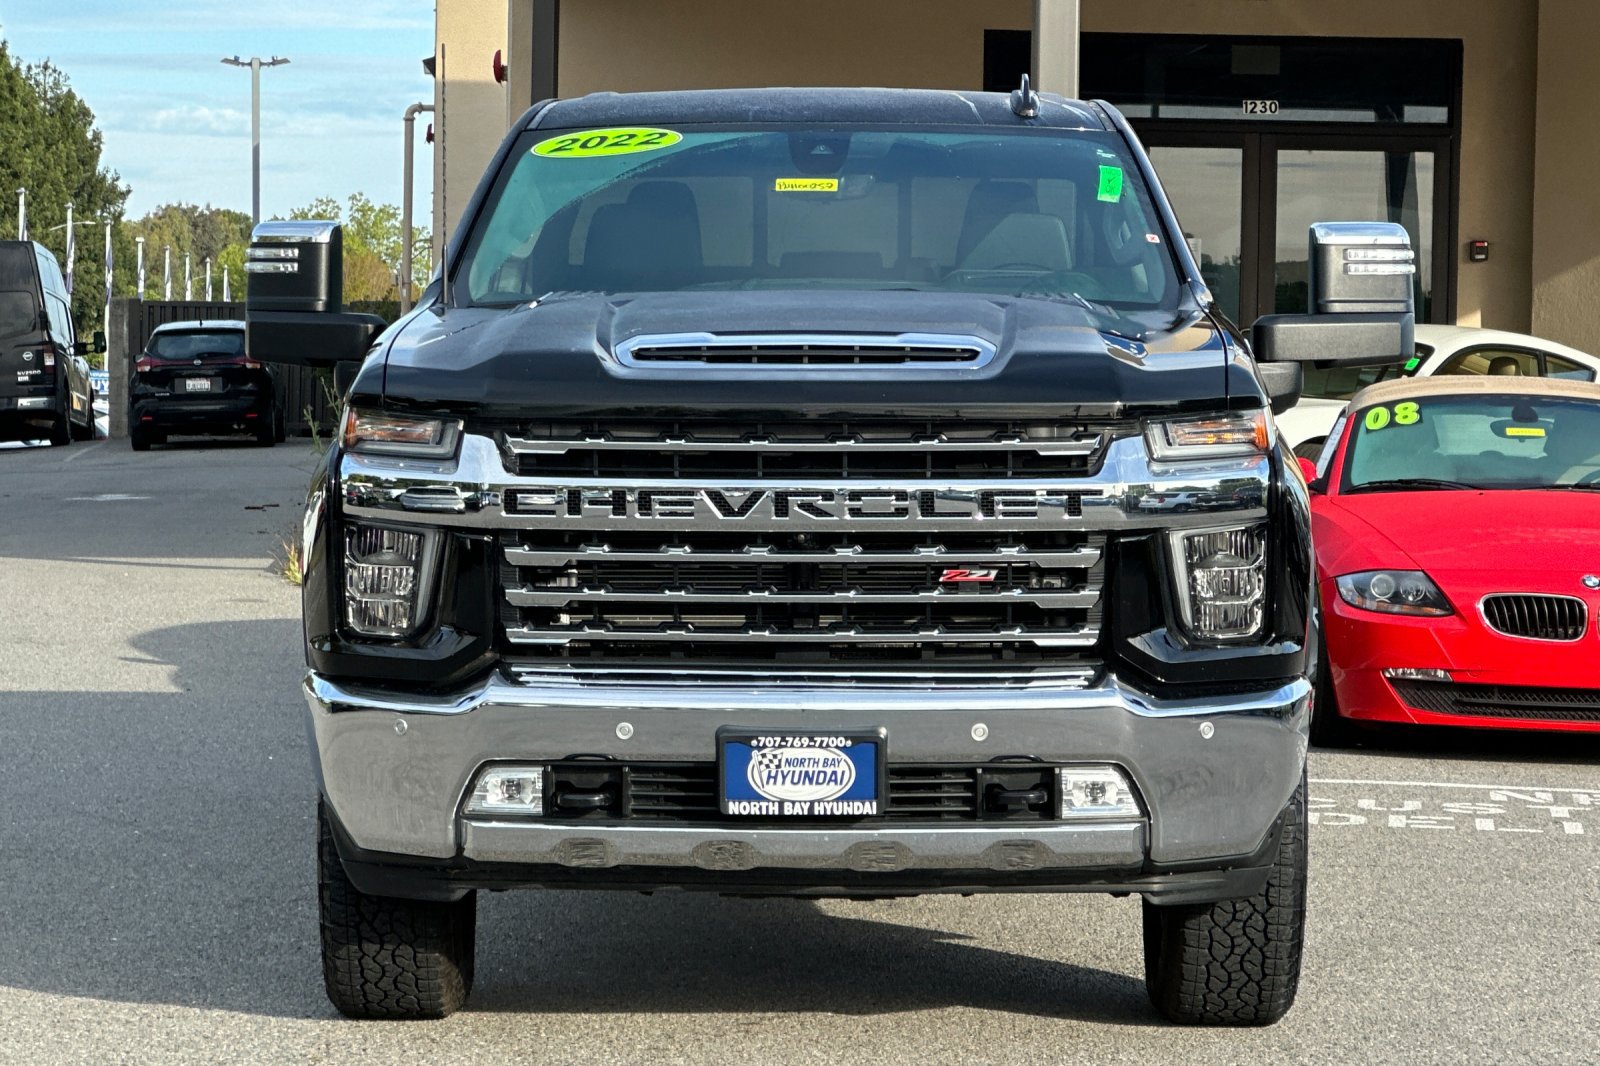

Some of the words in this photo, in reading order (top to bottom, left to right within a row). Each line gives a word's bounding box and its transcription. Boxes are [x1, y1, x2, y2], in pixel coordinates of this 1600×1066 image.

[1243, 101, 1278, 114] 1230
[547, 132, 669, 153] 2022
[1365, 401, 1420, 430] 08
[501, 488, 1104, 519] CHEVROLET
[939, 569, 999, 582] Z71
[758, 737, 846, 748] 707-769-7700
[785, 757, 820, 768] NORTH
[822, 757, 843, 768] BAY
[766, 770, 846, 786] HYUNDAI
[728, 802, 779, 815] NORTH
[784, 802, 810, 815] BAY
[814, 802, 877, 815] HYUNDAI
